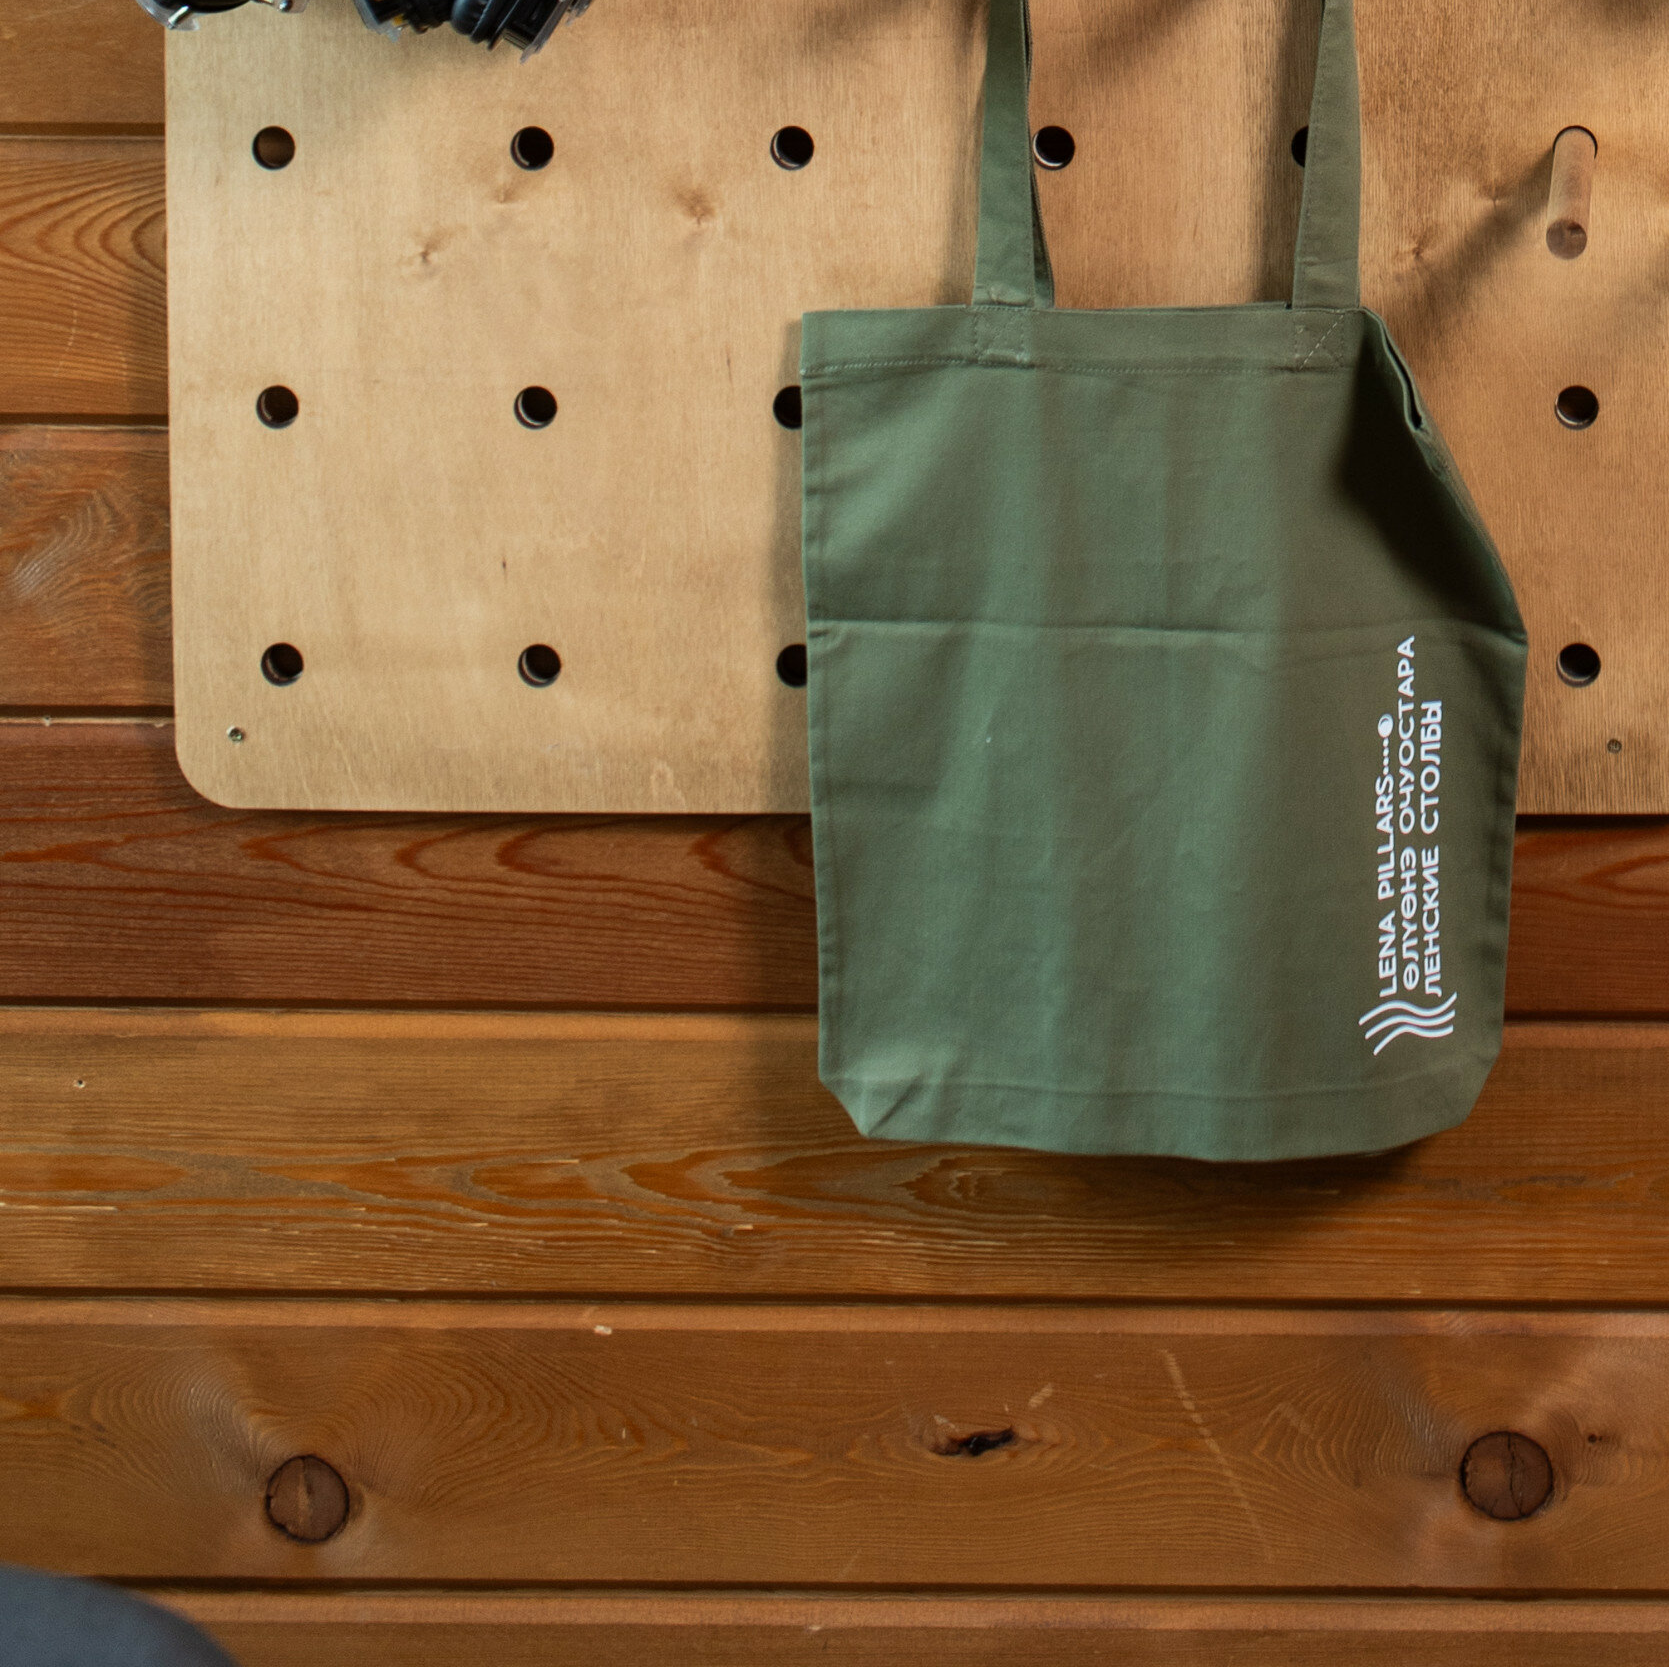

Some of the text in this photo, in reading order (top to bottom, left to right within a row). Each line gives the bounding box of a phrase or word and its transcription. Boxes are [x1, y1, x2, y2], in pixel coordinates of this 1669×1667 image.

[1397, 635, 1416, 835] ОЧУОСТАРА
[1375, 775, 1398, 998] LENA PILLARS
[1420, 700, 1443, 998] ЛЕНСКИЕ СТОЛБЫ
